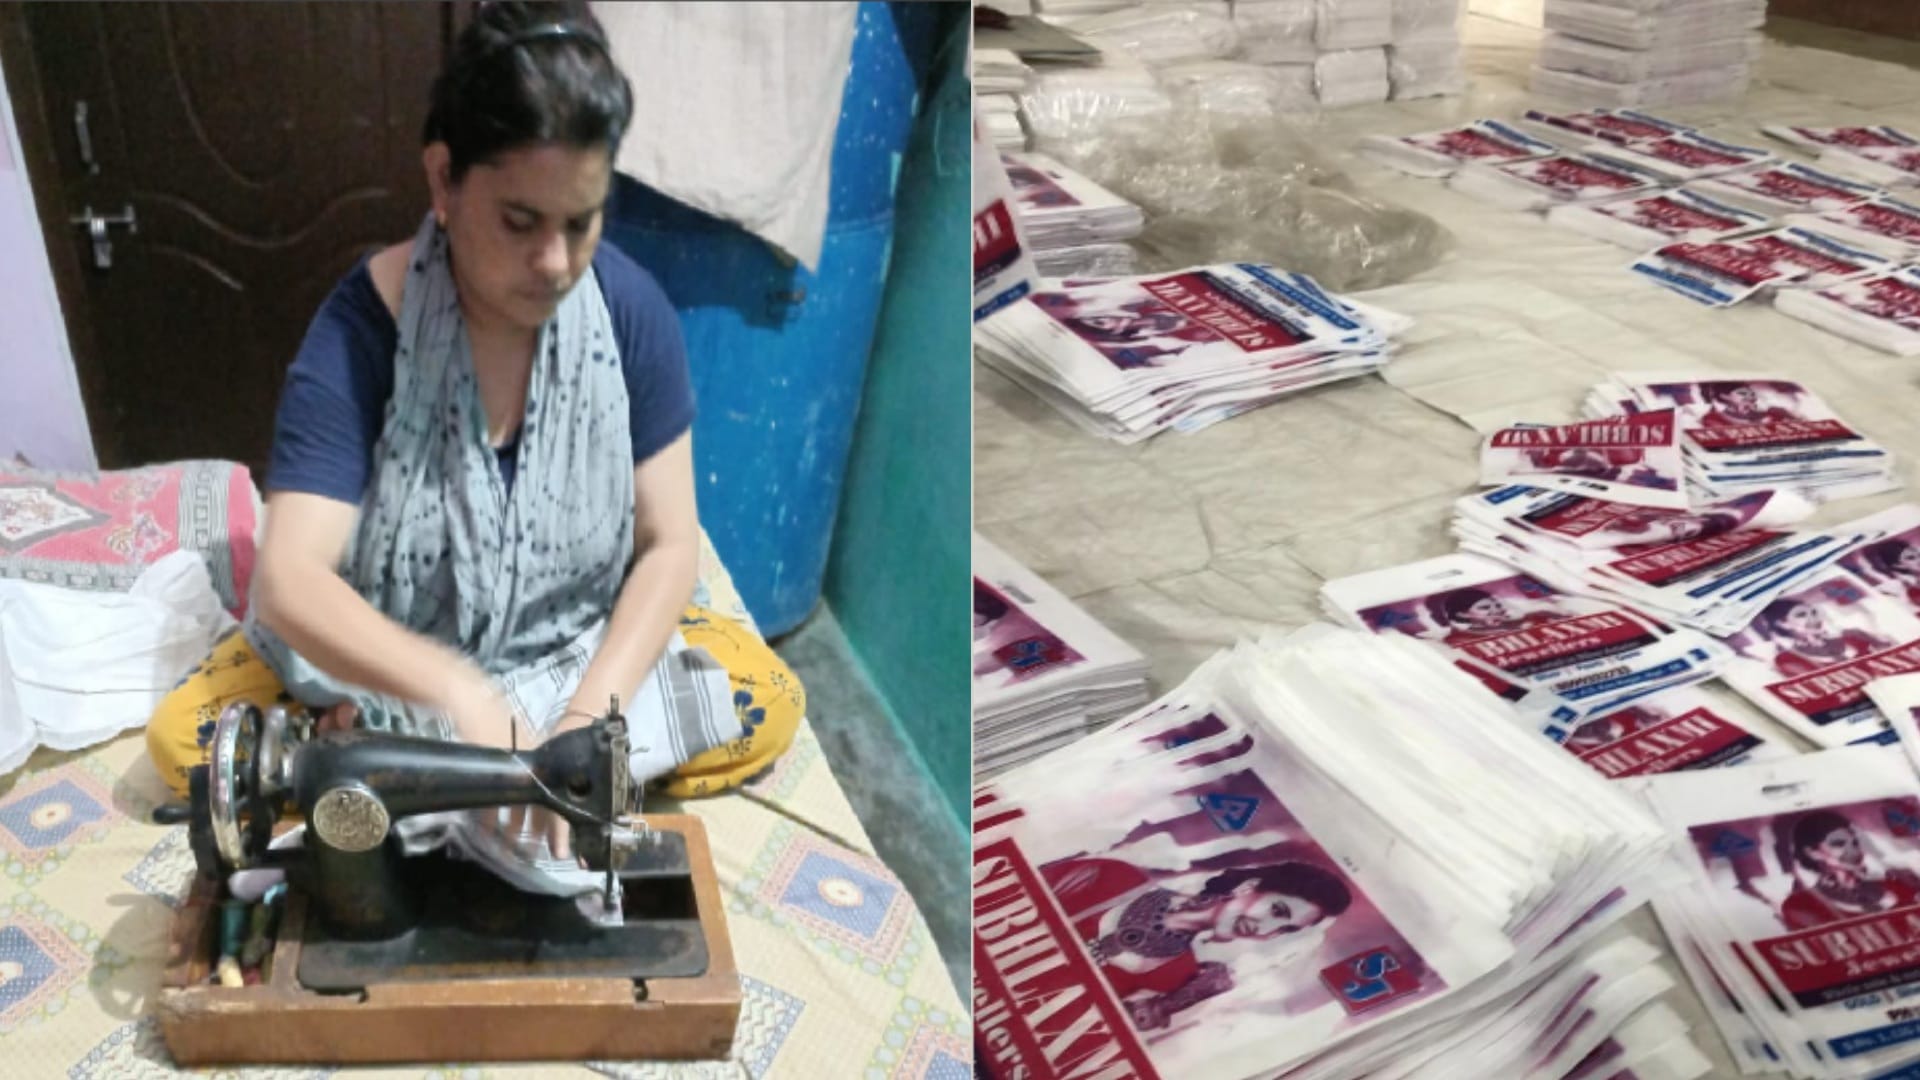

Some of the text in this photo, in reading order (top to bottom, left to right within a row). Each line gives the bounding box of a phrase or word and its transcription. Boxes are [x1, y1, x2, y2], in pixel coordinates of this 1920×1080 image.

[1474, 613, 1624, 659] BHLAXMI
[1777, 645, 1920, 704] SUBHLAX
[1590, 714, 1722, 777] HLAXMI
[974, 855, 1141, 1080] SUBHLAXM
[974, 976, 1031, 1080] ellers
